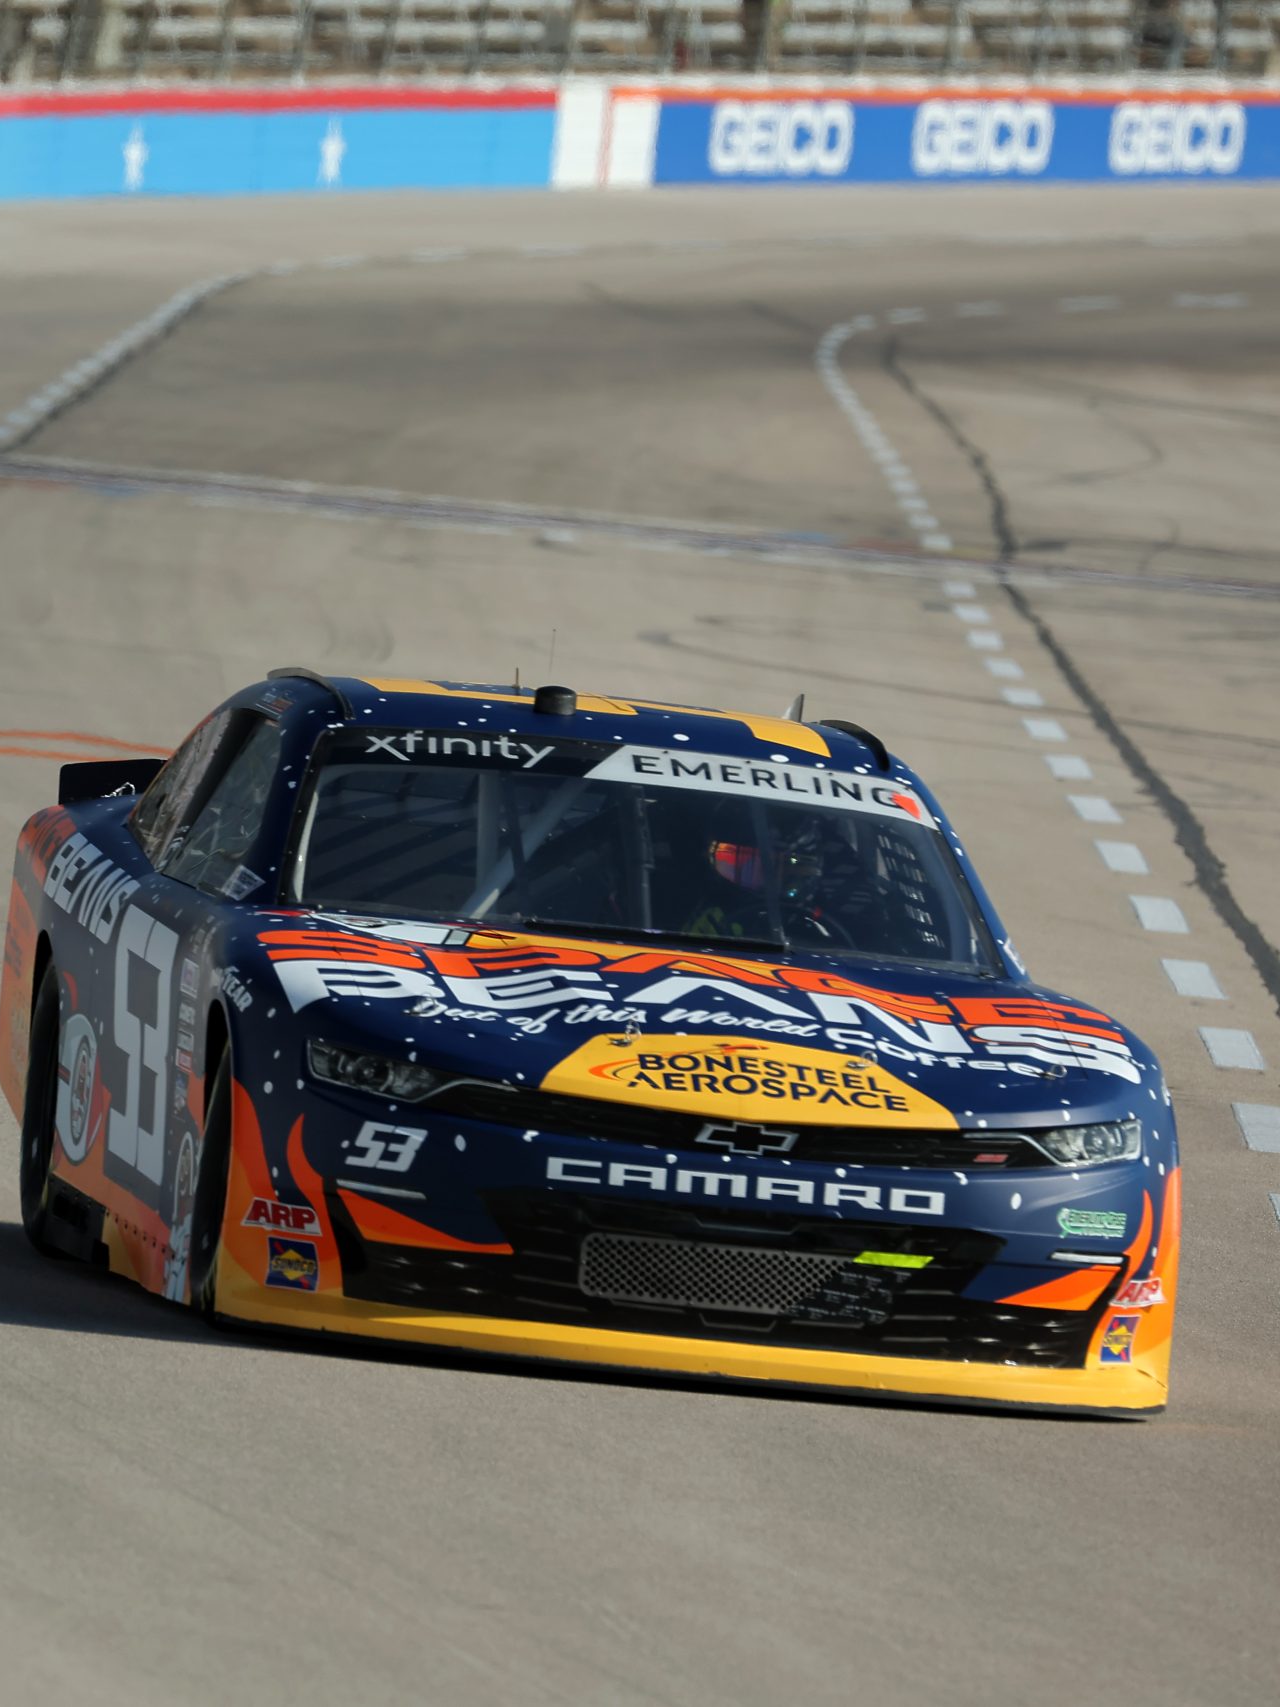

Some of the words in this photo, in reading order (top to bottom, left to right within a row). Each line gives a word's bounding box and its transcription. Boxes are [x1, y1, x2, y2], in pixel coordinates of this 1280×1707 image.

[708, 101, 854, 174] GEICO
[911, 101, 1054, 174] GEICO
[1109, 101, 1247, 173] GEICO
[365, 729, 555, 769] xfinity
[43, 832, 142, 945] BEANS
[272, 958, 1142, 1085] BEANS
[506, 1008, 561, 1034] of
[565, 1003, 647, 1025] this
[824, 1026, 1043, 1079] Coffee
[626, 1072, 910, 1113] AEROSPACE
[637, 1053, 891, 1095] BONESTEEL
[345, 1121, 428, 1173] 53
[247, 1199, 317, 1232] ARP
[546, 1155, 946, 1216] CAMARO
